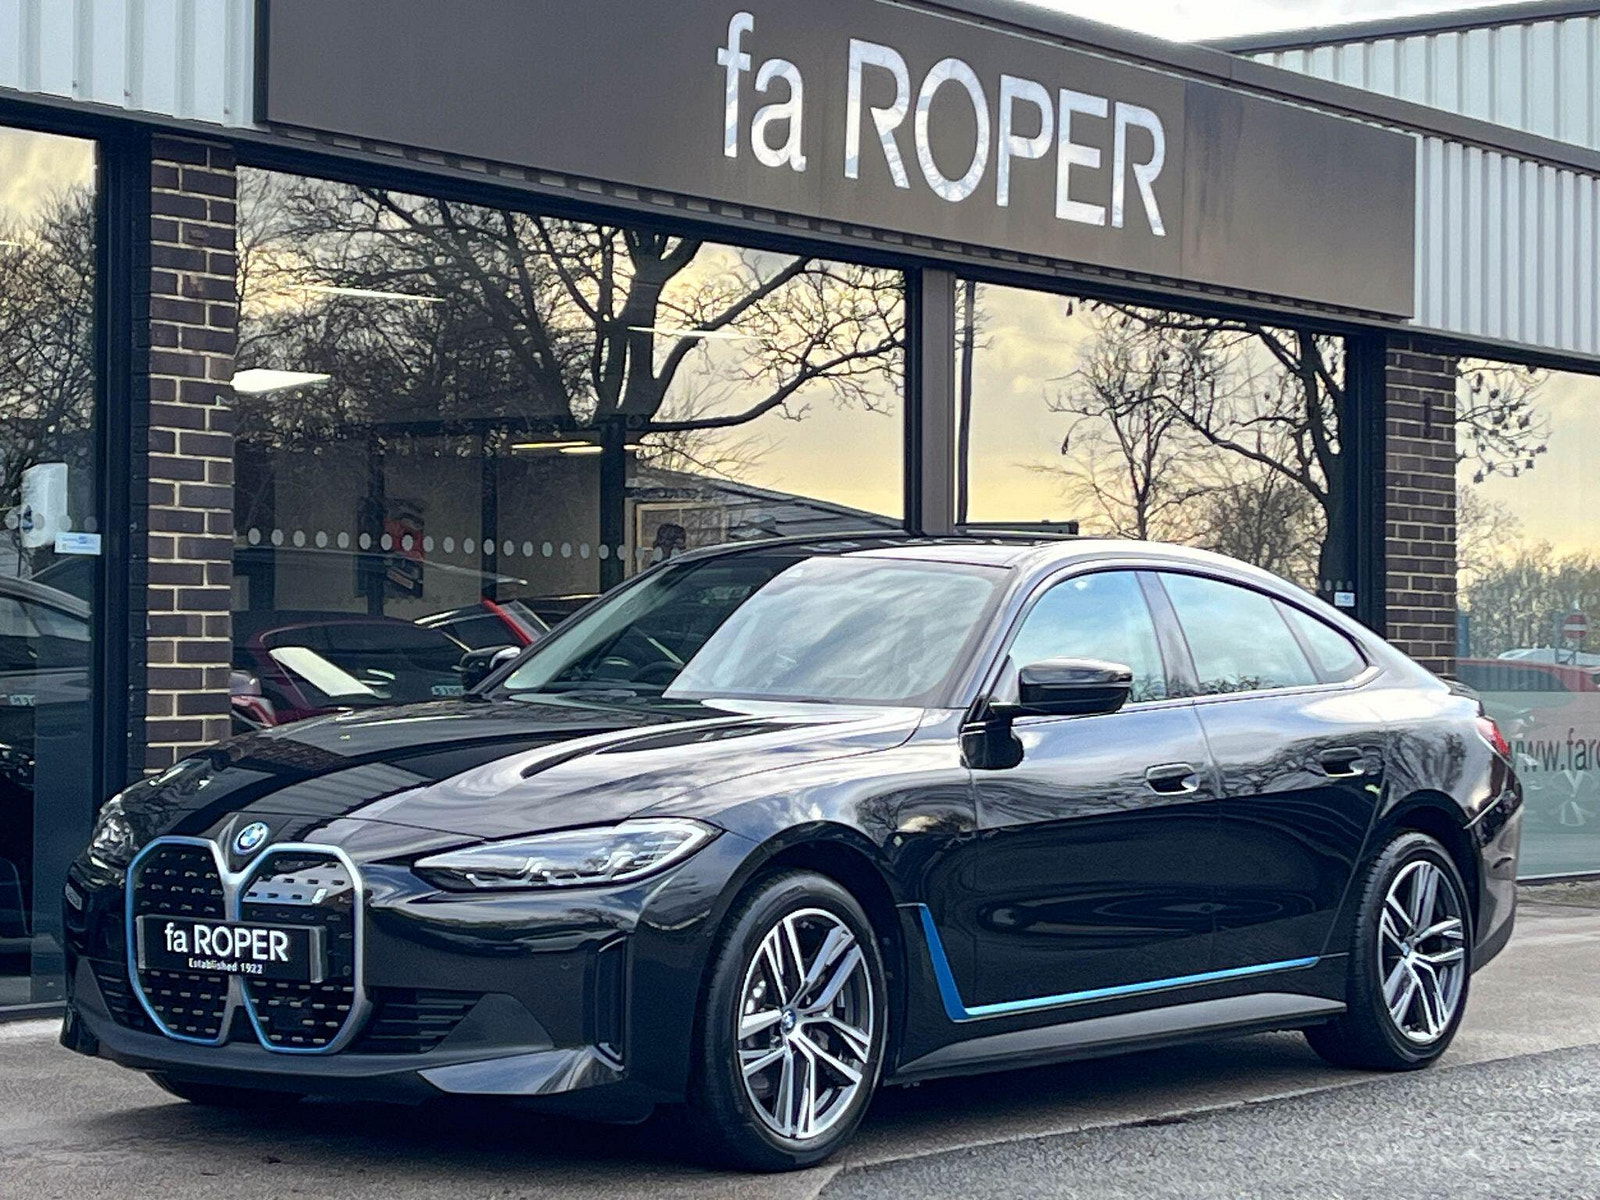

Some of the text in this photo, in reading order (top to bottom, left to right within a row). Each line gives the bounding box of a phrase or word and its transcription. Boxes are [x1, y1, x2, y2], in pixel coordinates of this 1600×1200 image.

[717, 11, 1167, 237] fa ROPER
[1508, 727, 1600, 773] ww.far
[164, 921, 289, 962] fa ROPER
[188, 957, 263, 975] Established 1922
